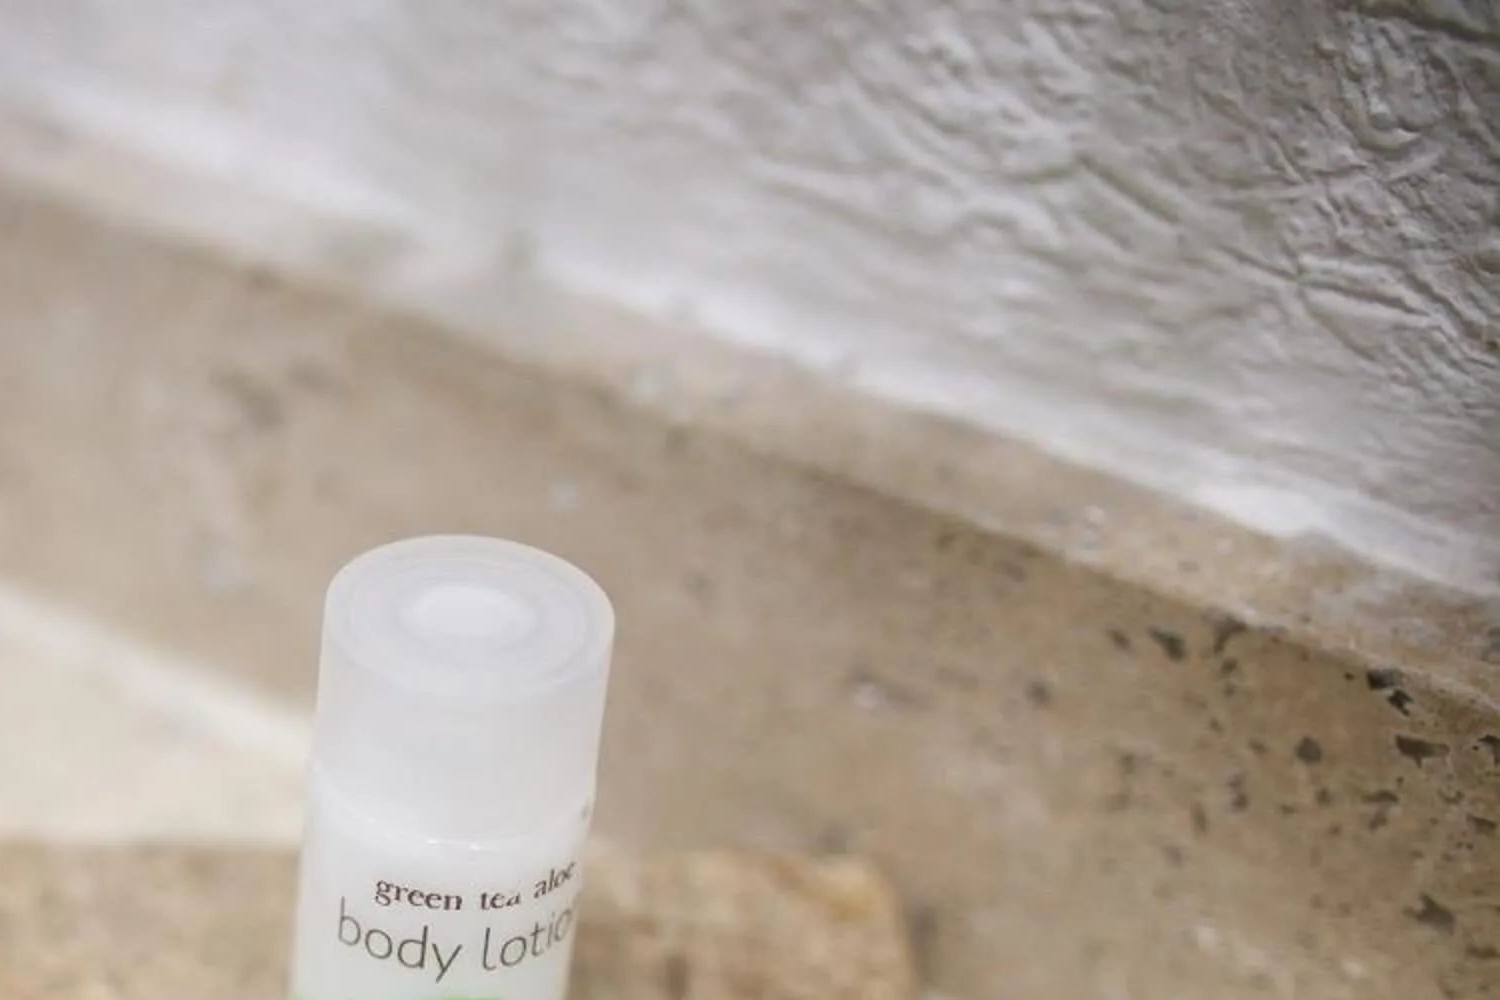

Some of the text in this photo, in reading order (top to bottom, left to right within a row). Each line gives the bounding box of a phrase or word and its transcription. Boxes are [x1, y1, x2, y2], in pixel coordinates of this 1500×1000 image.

[373, 861, 576, 912] green tea aloe
[337, 895, 576, 984] body lotio
